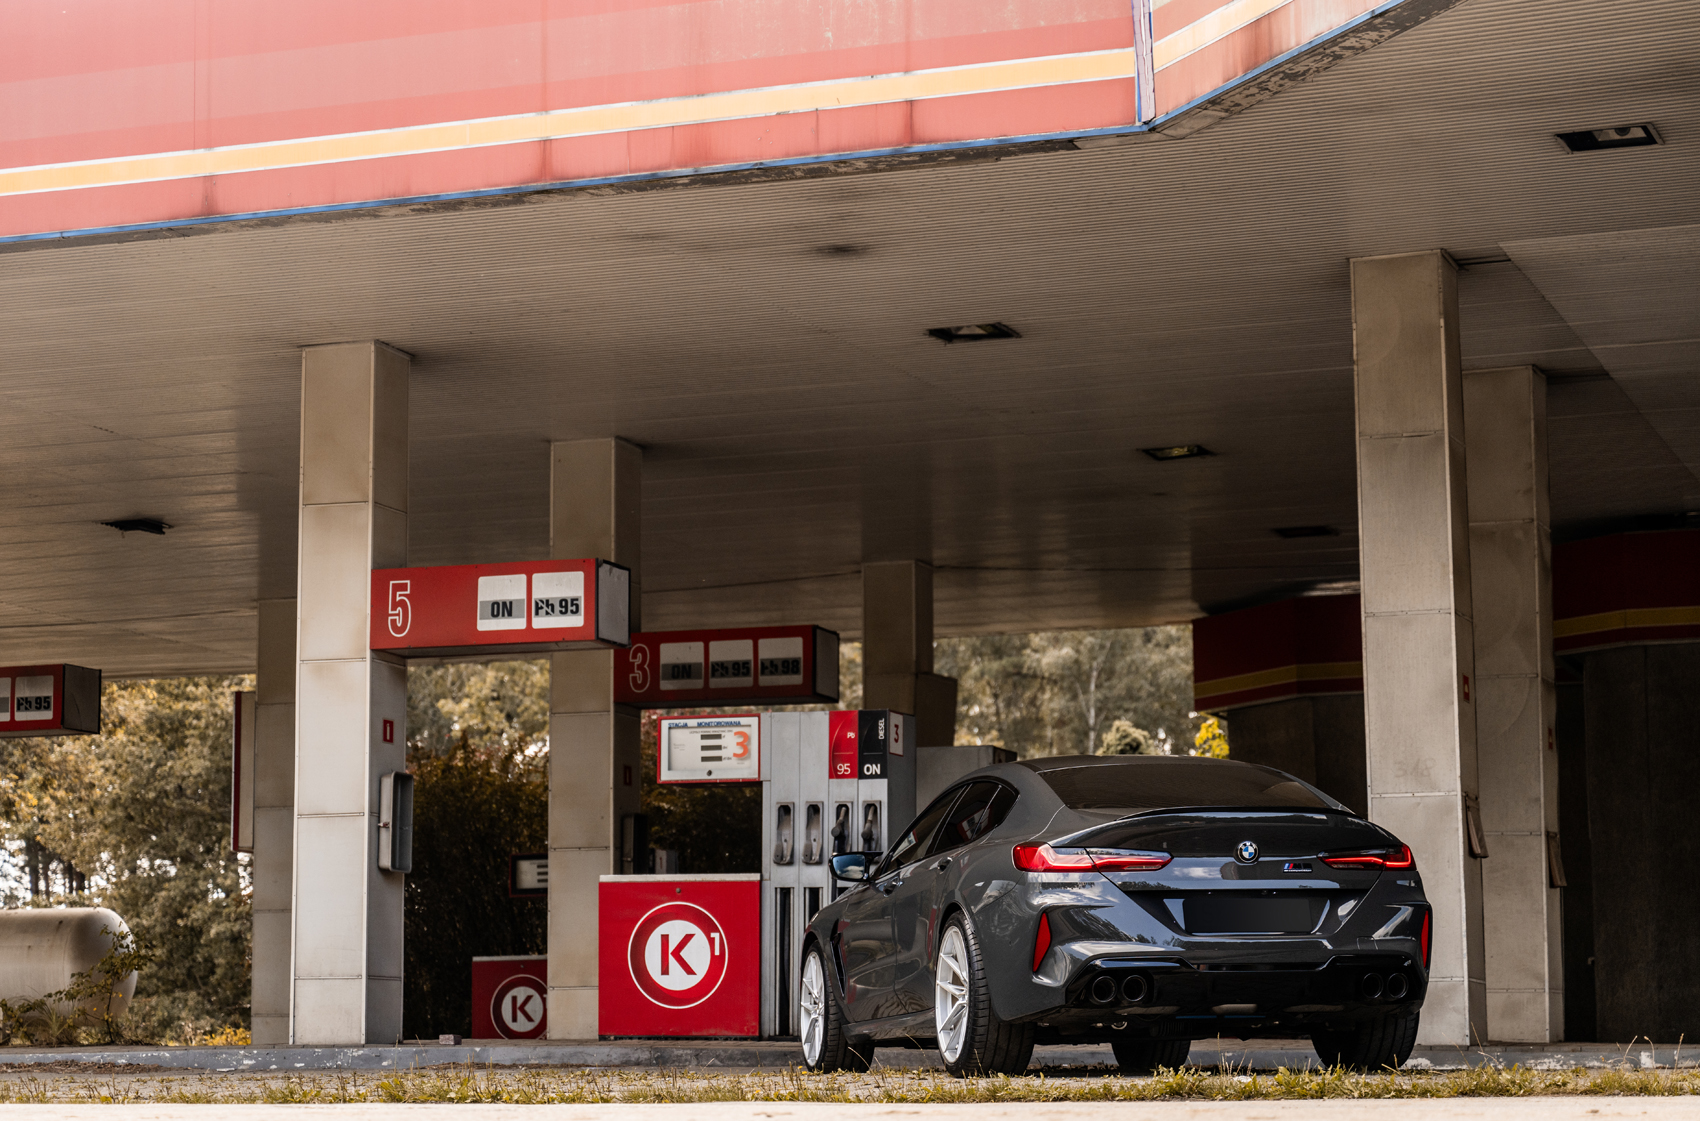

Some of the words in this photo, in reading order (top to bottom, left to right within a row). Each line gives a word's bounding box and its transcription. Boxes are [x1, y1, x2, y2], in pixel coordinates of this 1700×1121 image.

[388, 580, 411, 637] 5
[490, 601, 513, 618] ON
[534, 599, 555, 616] Pb
[558, 598, 580, 615] 95
[629, 643, 650, 693] 3
[671, 664, 692, 679] ON
[732, 661, 750, 676] 95
[781, 659, 800, 674] 98
[34, 696, 51, 710] 95
[846, 731, 856, 739] Pb
[894, 724, 900, 743] 3
[733, 731, 749, 758] 3
[837, 763, 851, 775] 95
[863, 763, 881, 775] ON
[660, 933, 698, 976] K
[710, 932, 720, 956] 1
[511, 994, 535, 1023] K
